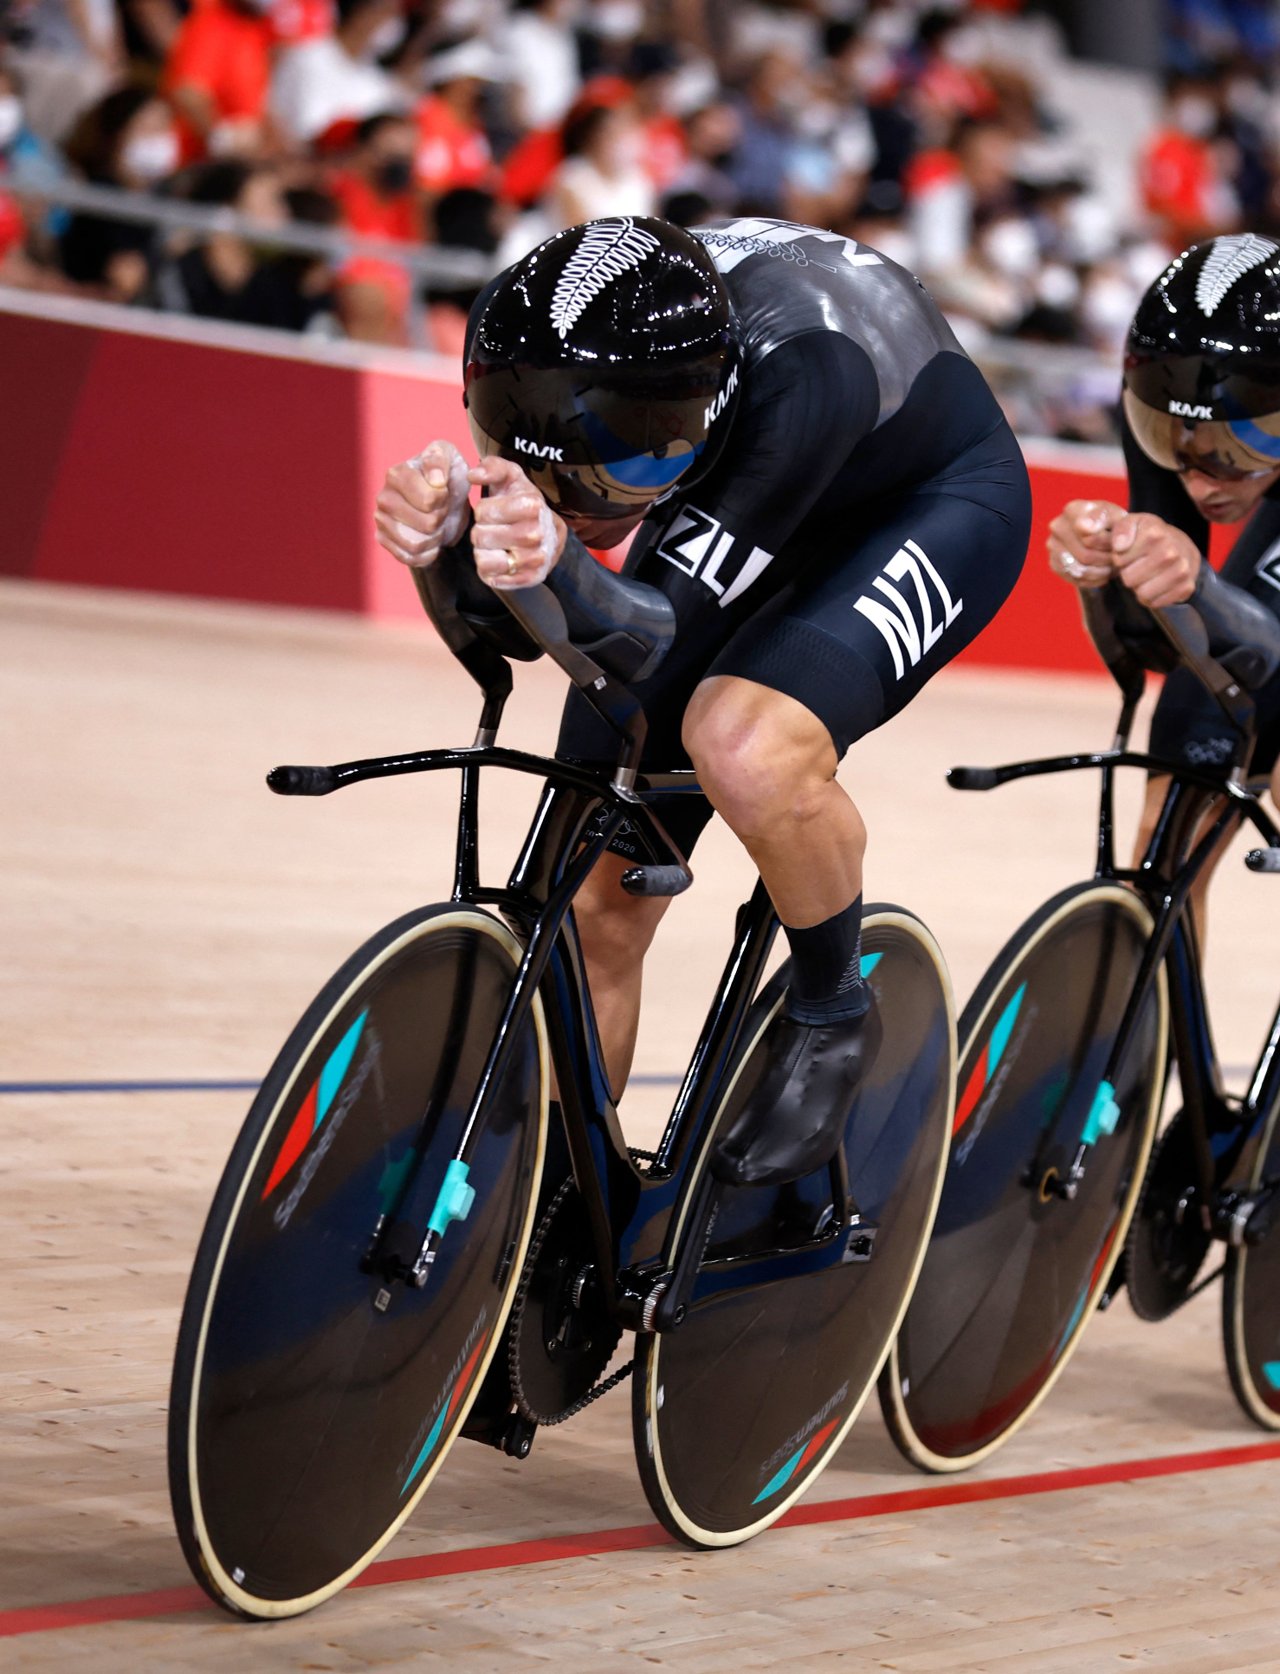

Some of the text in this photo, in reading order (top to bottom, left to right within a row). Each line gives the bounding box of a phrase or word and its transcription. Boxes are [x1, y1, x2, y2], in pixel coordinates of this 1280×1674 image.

[703, 363, 738, 430] KASK
[1169, 400, 1213, 420] KASK
[514, 436, 563, 462] KASK
[853, 539, 963, 681] NZL
[612, 839, 636, 854] 2020
